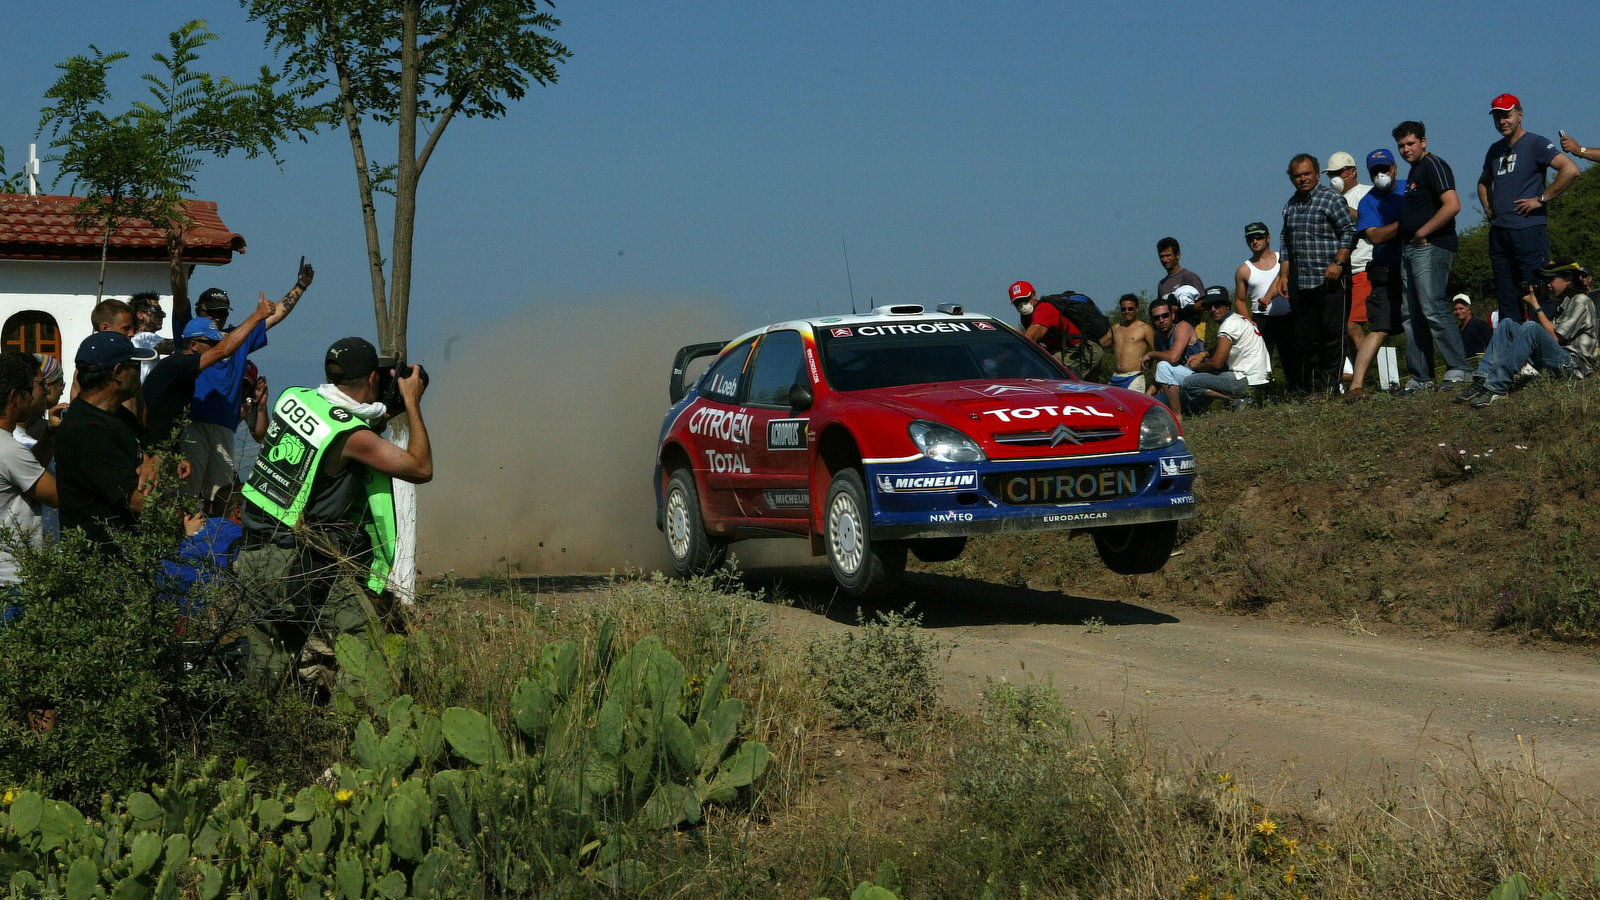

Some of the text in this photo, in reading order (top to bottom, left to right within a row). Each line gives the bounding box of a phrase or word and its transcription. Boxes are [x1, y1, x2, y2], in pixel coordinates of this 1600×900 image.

[858, 321, 972, 336] CITROËN
[717, 375, 737, 397] Loeb
[281, 399, 320, 436] 095
[333, 408, 349, 420] GR
[982, 405, 1115, 422] TOTAL
[689, 406, 753, 445] CITROËN
[771, 422, 800, 446] ACROPOLIS
[705, 449, 751, 474] TOTAL
[895, 475, 974, 488] MICHELIN
[1007, 468, 1137, 501] CITROËN
[775, 494, 810, 504] MICHELIN
[930, 513, 974, 523] NAVTEQ
[1043, 512, 1108, 523] EURODATACAR
